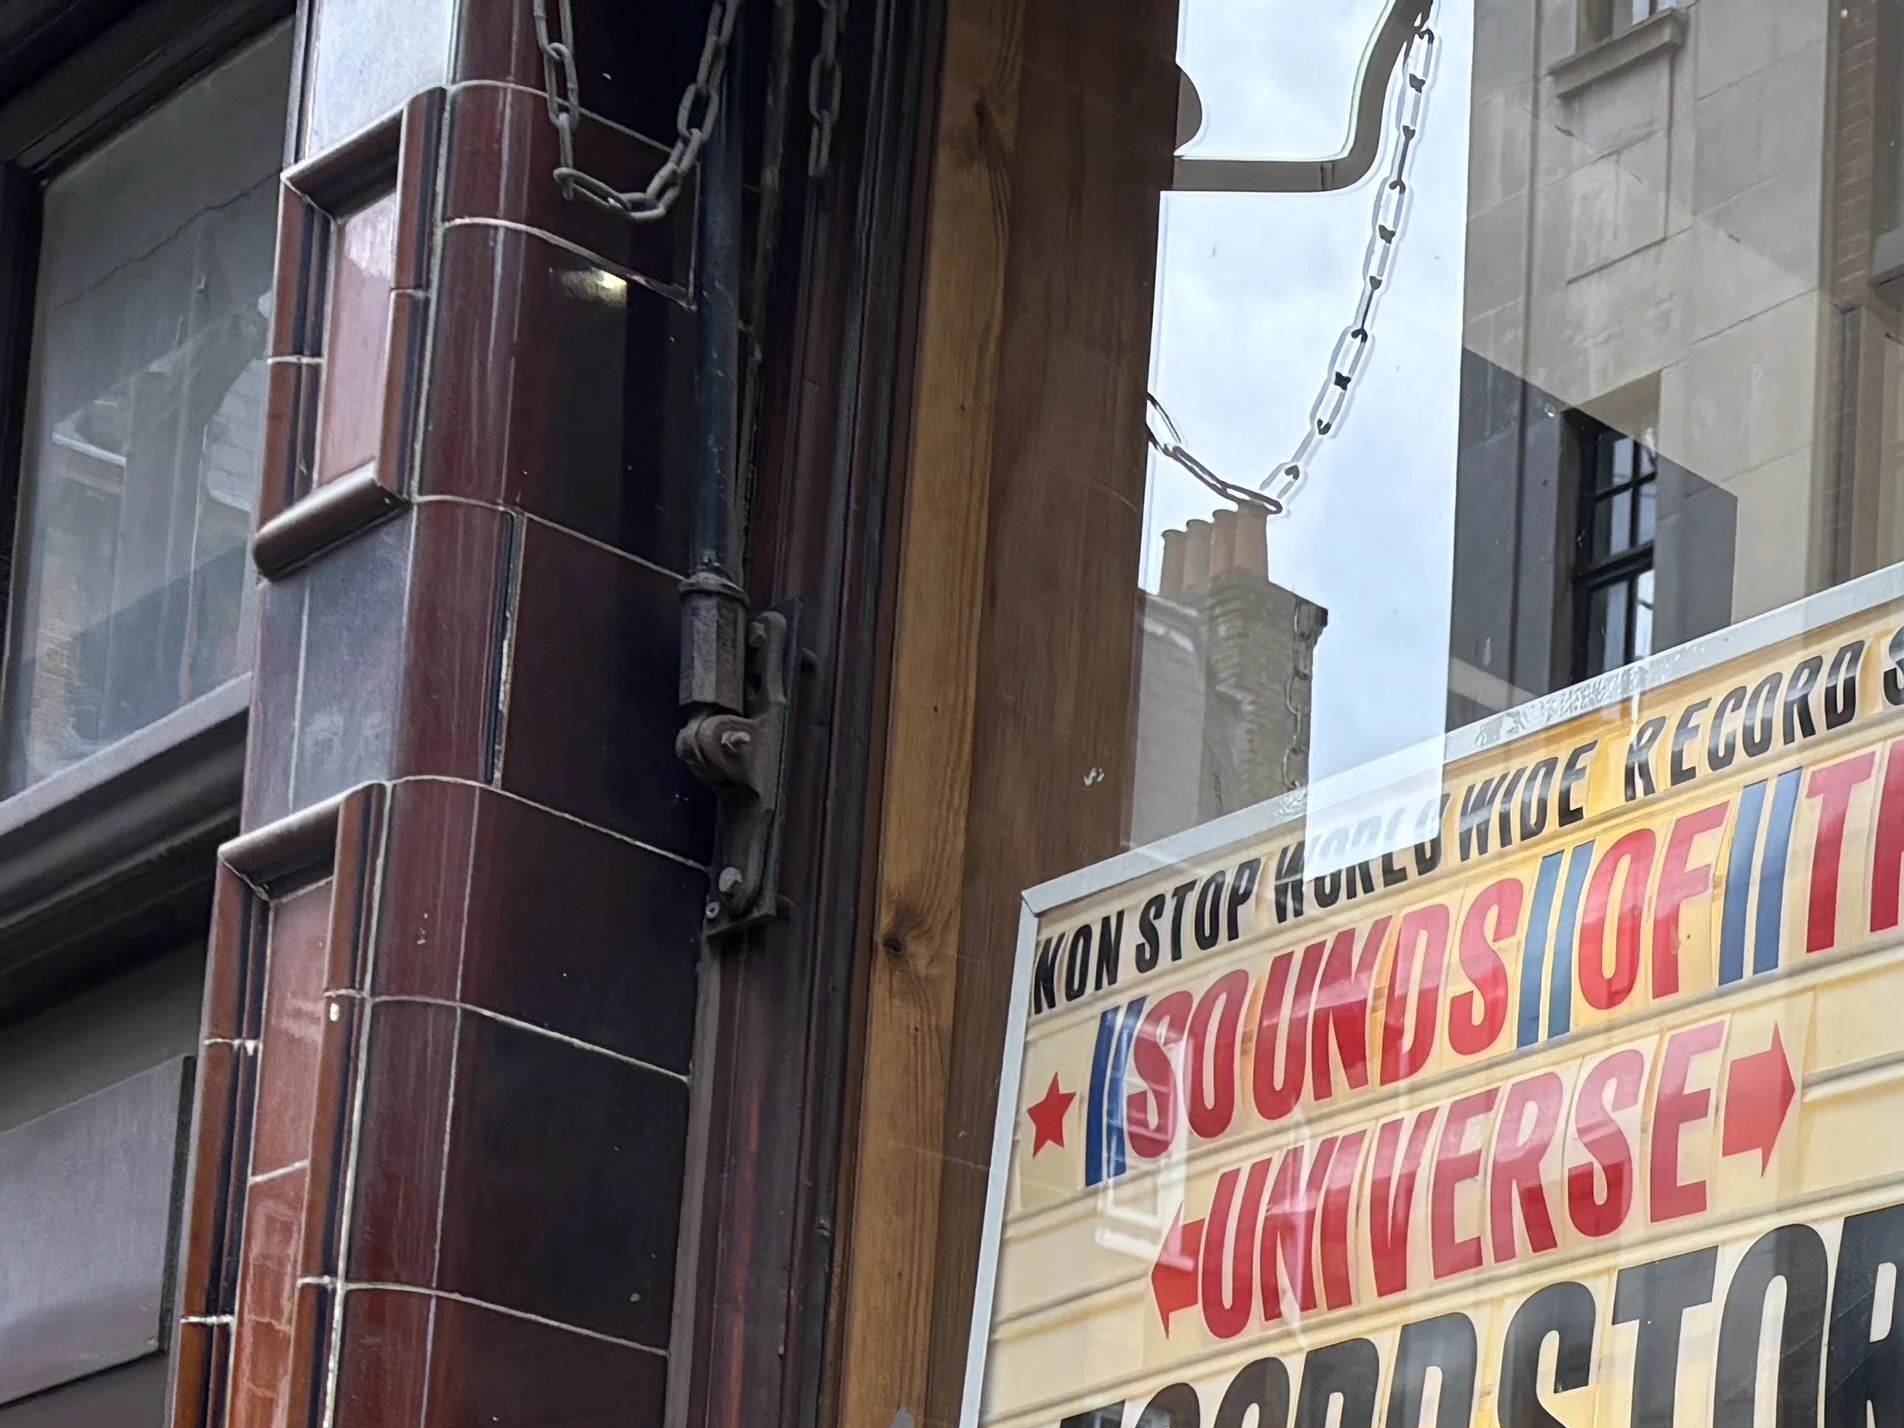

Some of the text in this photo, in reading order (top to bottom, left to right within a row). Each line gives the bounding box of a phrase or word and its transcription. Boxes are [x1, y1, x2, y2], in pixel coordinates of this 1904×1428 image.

[1033, 909, 1125, 1015] NON
[1135, 856, 1262, 973] STOP
[1275, 792, 1450, 923] WORLD
[1458, 739, 1598, 861] WIDE
[1625, 639, 1866, 801] RECORD
[1126, 877, 1523, 1158] SOUNDS
[1578, 801, 1731, 1011] OF
[1200, 1019, 1726, 1340] UNIVERSE
